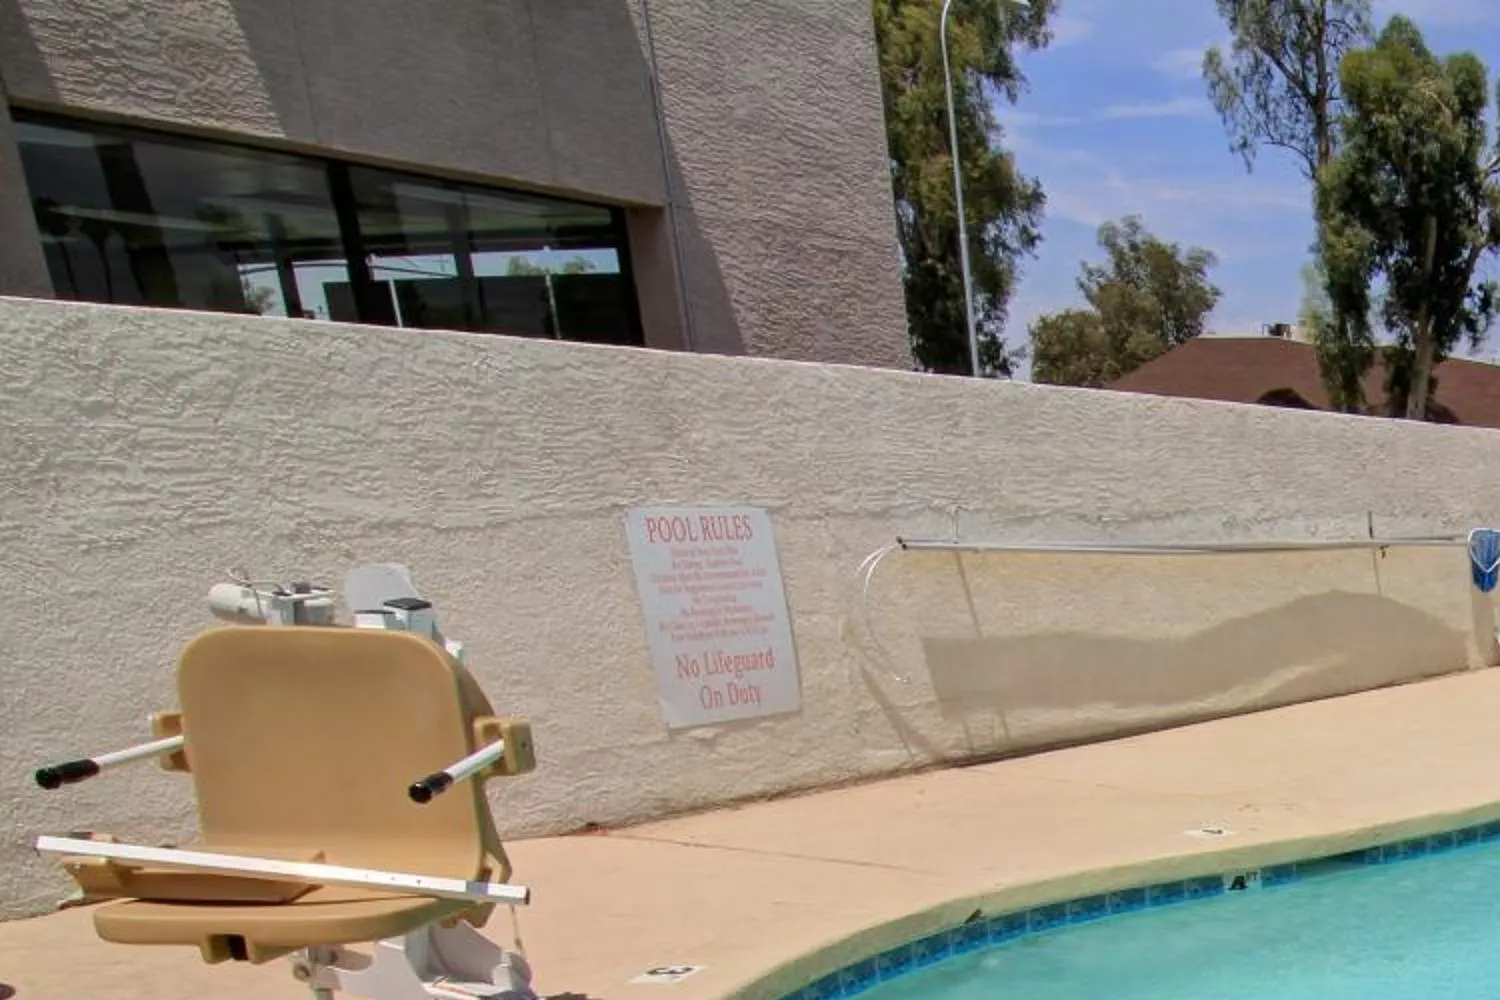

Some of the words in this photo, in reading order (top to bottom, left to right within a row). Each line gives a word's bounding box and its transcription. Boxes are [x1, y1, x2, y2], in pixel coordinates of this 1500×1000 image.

[645, 515, 698, 543] POOL
[699, 514, 753, 541] RULES
[675, 654, 700, 679] No
[703, 646, 776, 680] Lifeguard
[699, 684, 723, 709] On
[726, 681, 763, 708] Duty
